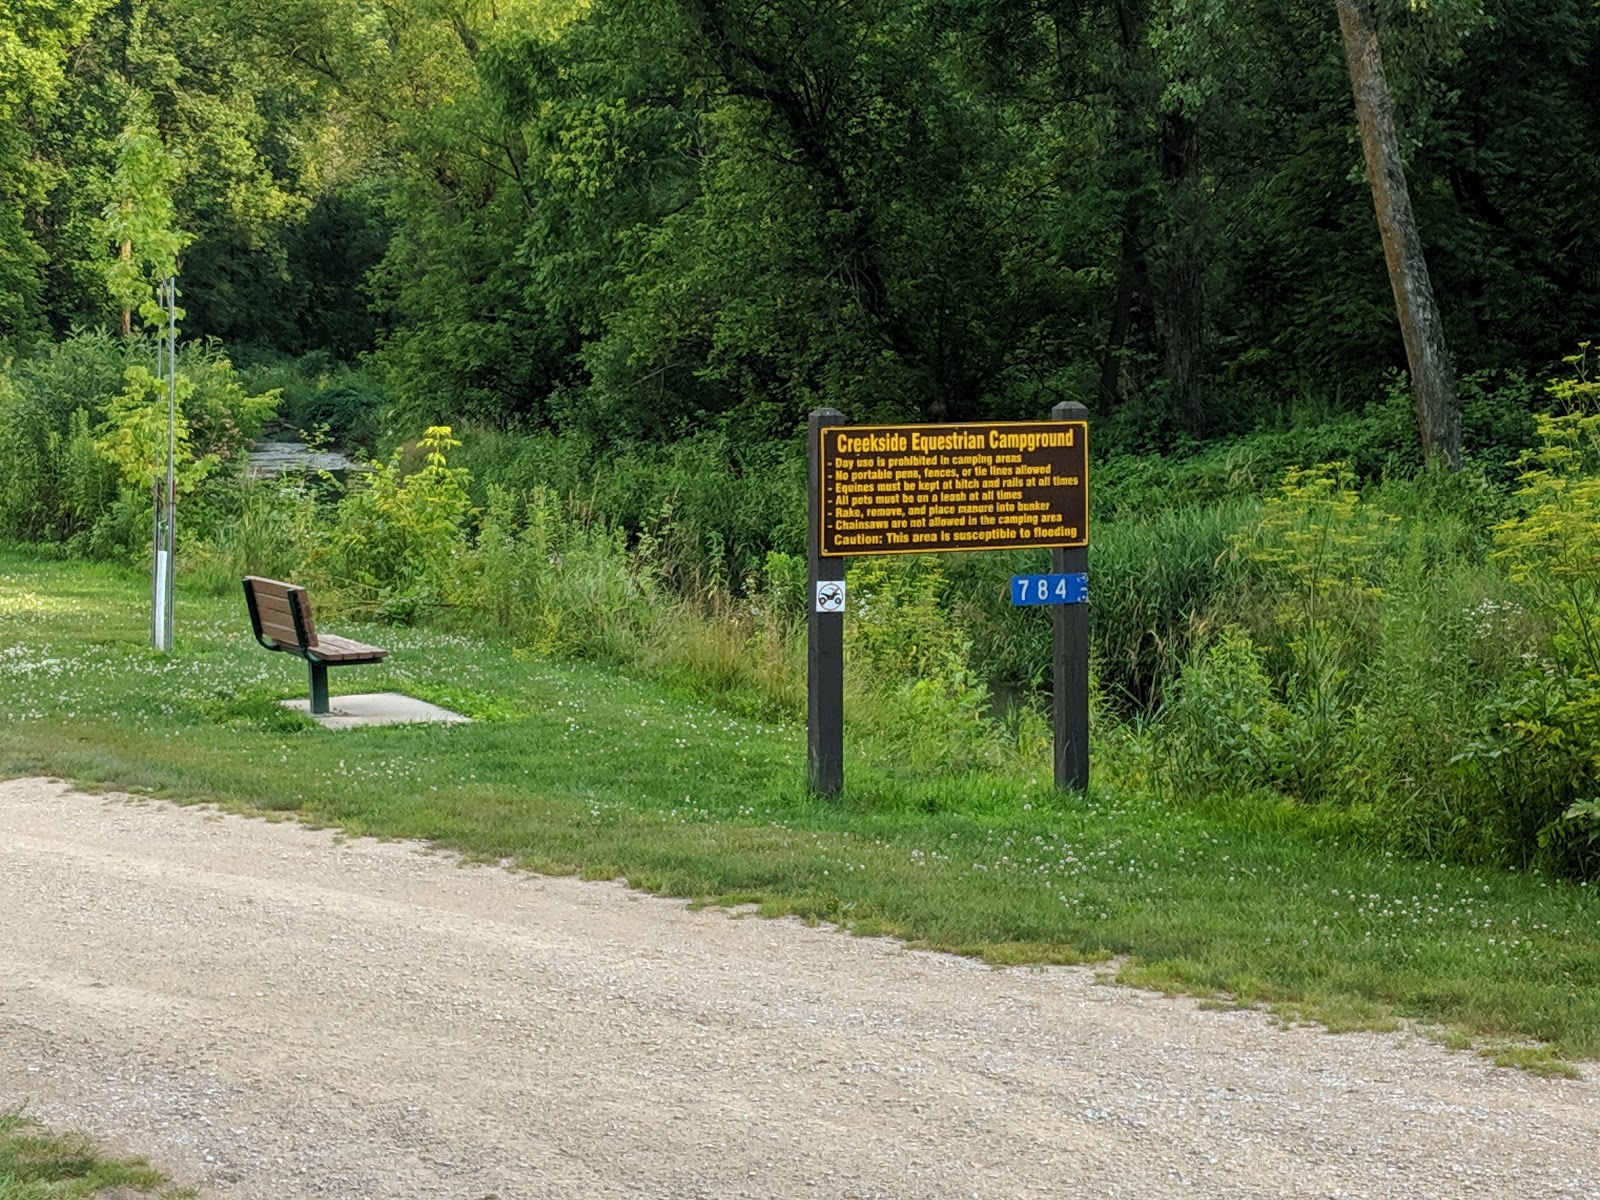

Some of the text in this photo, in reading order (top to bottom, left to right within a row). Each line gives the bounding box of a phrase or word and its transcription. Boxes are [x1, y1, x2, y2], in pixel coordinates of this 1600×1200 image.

[837, 428, 1074, 454] Creekside Equestrian Campground
[836, 458, 854, 469] Day
[877, 457, 885, 466] is
[888, 456, 937, 469] prohibited
[940, 456, 949, 464] in
[952, 454, 992, 466] camping
[996, 454, 1022, 463] areas
[836, 471, 848, 480] No
[852, 469, 892, 481] portable
[924, 468, 959, 478] fences,
[975, 466, 987, 476] tie
[990, 466, 1012, 475] lines
[1015, 464, 1051, 475] allowed
[836, 483, 874, 494] Equines
[878, 482, 900, 491] must
[904, 481, 915, 490] be
[919, 481, 939, 492] kept
[1003, 478, 1023, 487] rails
[1039, 477, 1050, 486] all
[1053, 476, 1078, 486] times
[836, 496, 848, 505] All
[852, 496, 872, 506] pets
[876, 494, 899, 504] must
[903, 494, 914, 503] be
[941, 492, 966, 502] leash
[982, 490, 994, 500] all
[997, 490, 1022, 500] times
[836, 508, 863, 518] Rake,
[929, 504, 955, 516] place
[997, 503, 1014, 512] into
[891, 520, 907, 528] are
[910, 518, 926, 527] not
[929, 516, 965, 526] allowed
[968, 515, 977, 525] in
[980, 515, 995, 524] the
[998, 513, 1038, 525] camping
[1041, 514, 1062, 522] area
[834, 534, 882, 545] Caution:
[886, 532, 909, 543] This
[912, 533, 937, 542] area
[941, 531, 950, 541] is
[954, 528, 1016, 541] susceptible
[1020, 528, 1030, 538] to
